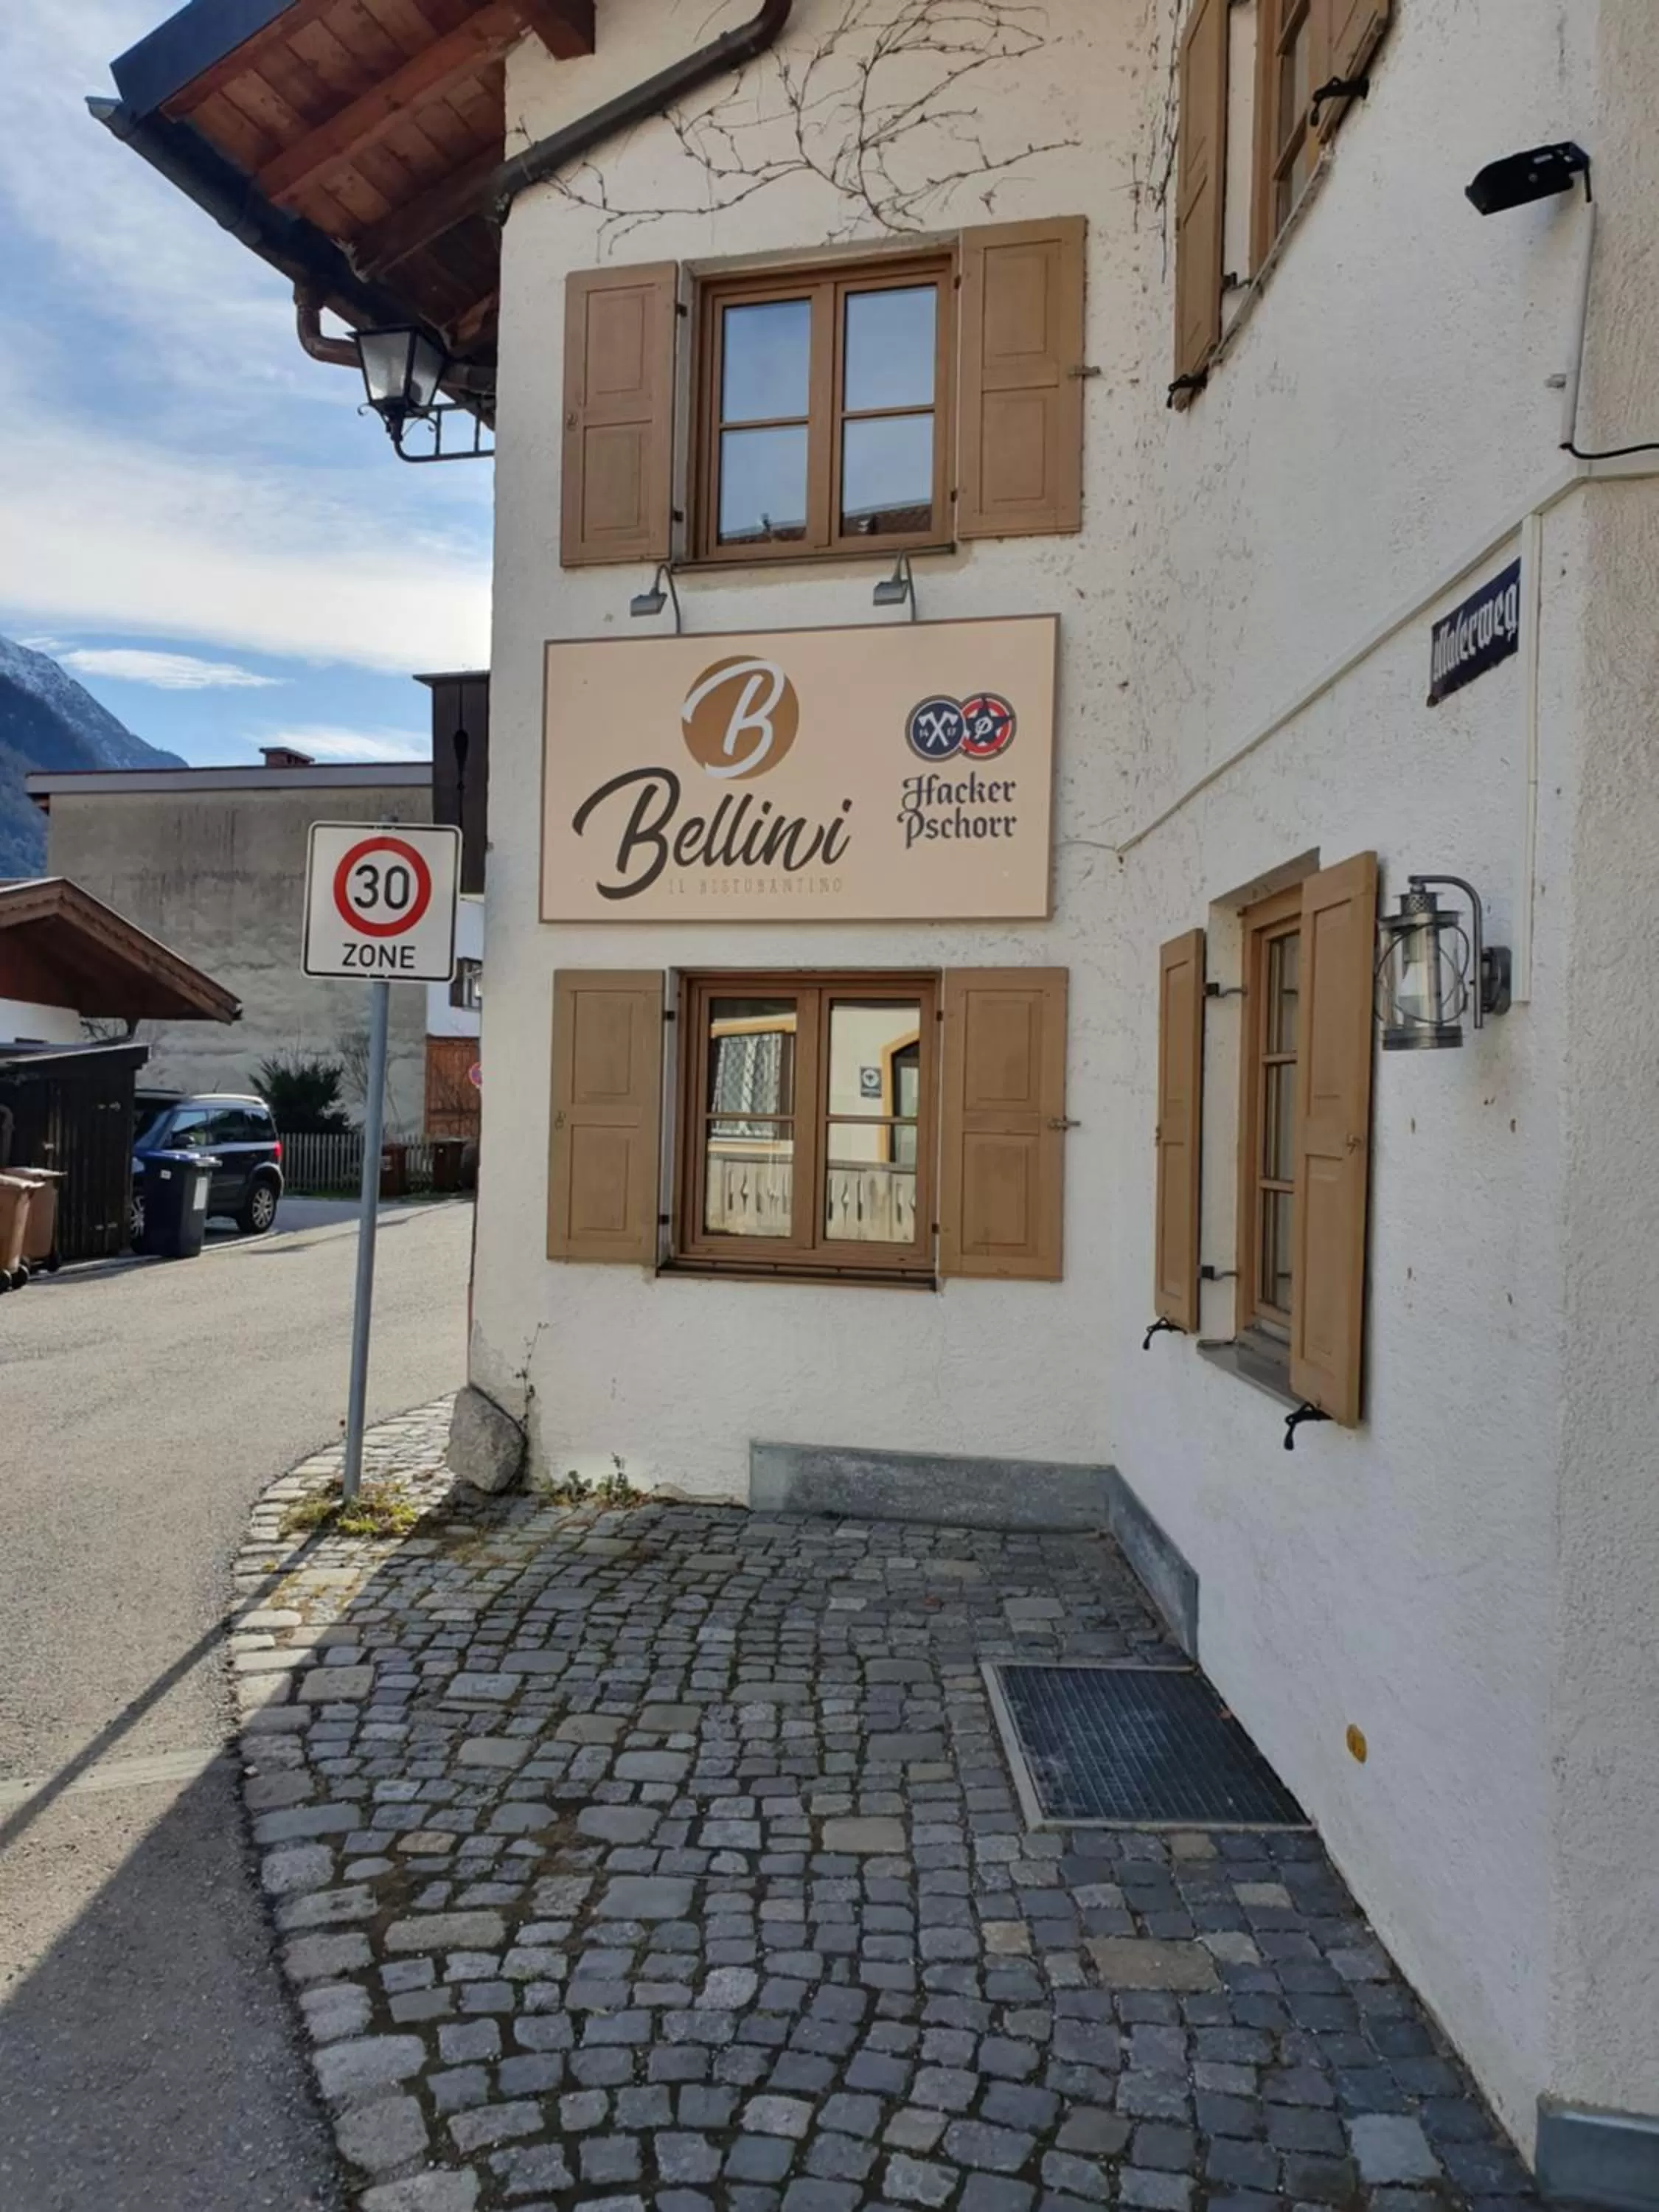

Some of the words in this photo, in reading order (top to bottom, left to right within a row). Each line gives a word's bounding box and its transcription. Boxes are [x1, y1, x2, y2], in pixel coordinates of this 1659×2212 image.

[681, 658, 786, 779] B
[901, 771, 1018, 812] Hacker
[571, 766, 853, 900] Bellini
[897, 806, 1018, 849] Pschorr
[353, 863, 411, 911] 30
[341, 942, 417, 970] ZONE
